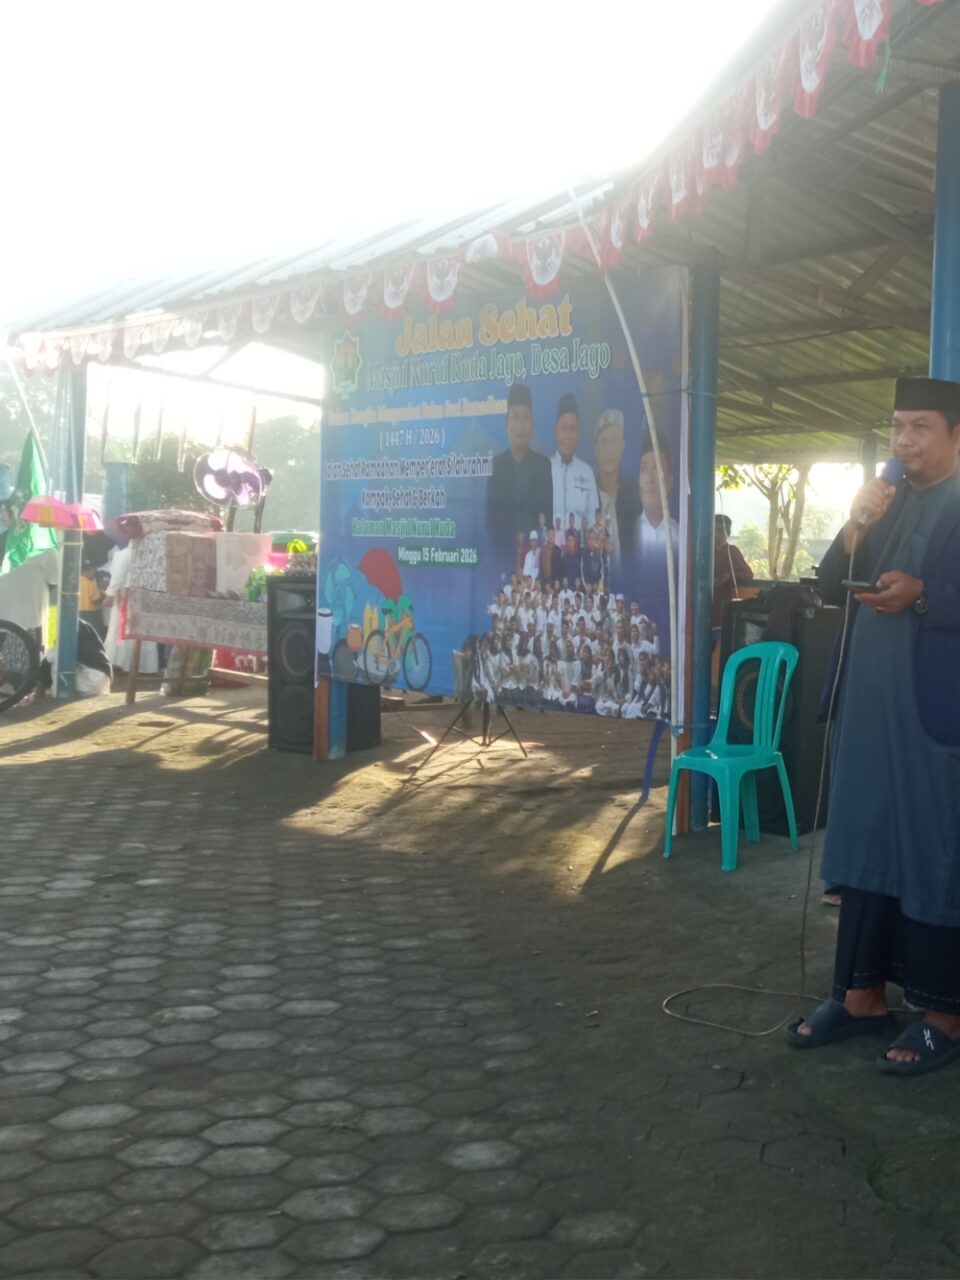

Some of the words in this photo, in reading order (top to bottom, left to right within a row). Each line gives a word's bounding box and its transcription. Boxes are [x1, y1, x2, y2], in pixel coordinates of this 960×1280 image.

[395, 312, 473, 357] Jalan
[479, 293, 573, 346] Sehat
[450, 349, 488, 384] Huda
[489, 348, 527, 386] Jago,
[530, 343, 569, 375] Desa
[571, 338, 611, 379] Jago
[398, 546, 421, 565] Minggu
[430, 547, 459, 563] Februari
[460, 548, 478, 563] 2026
